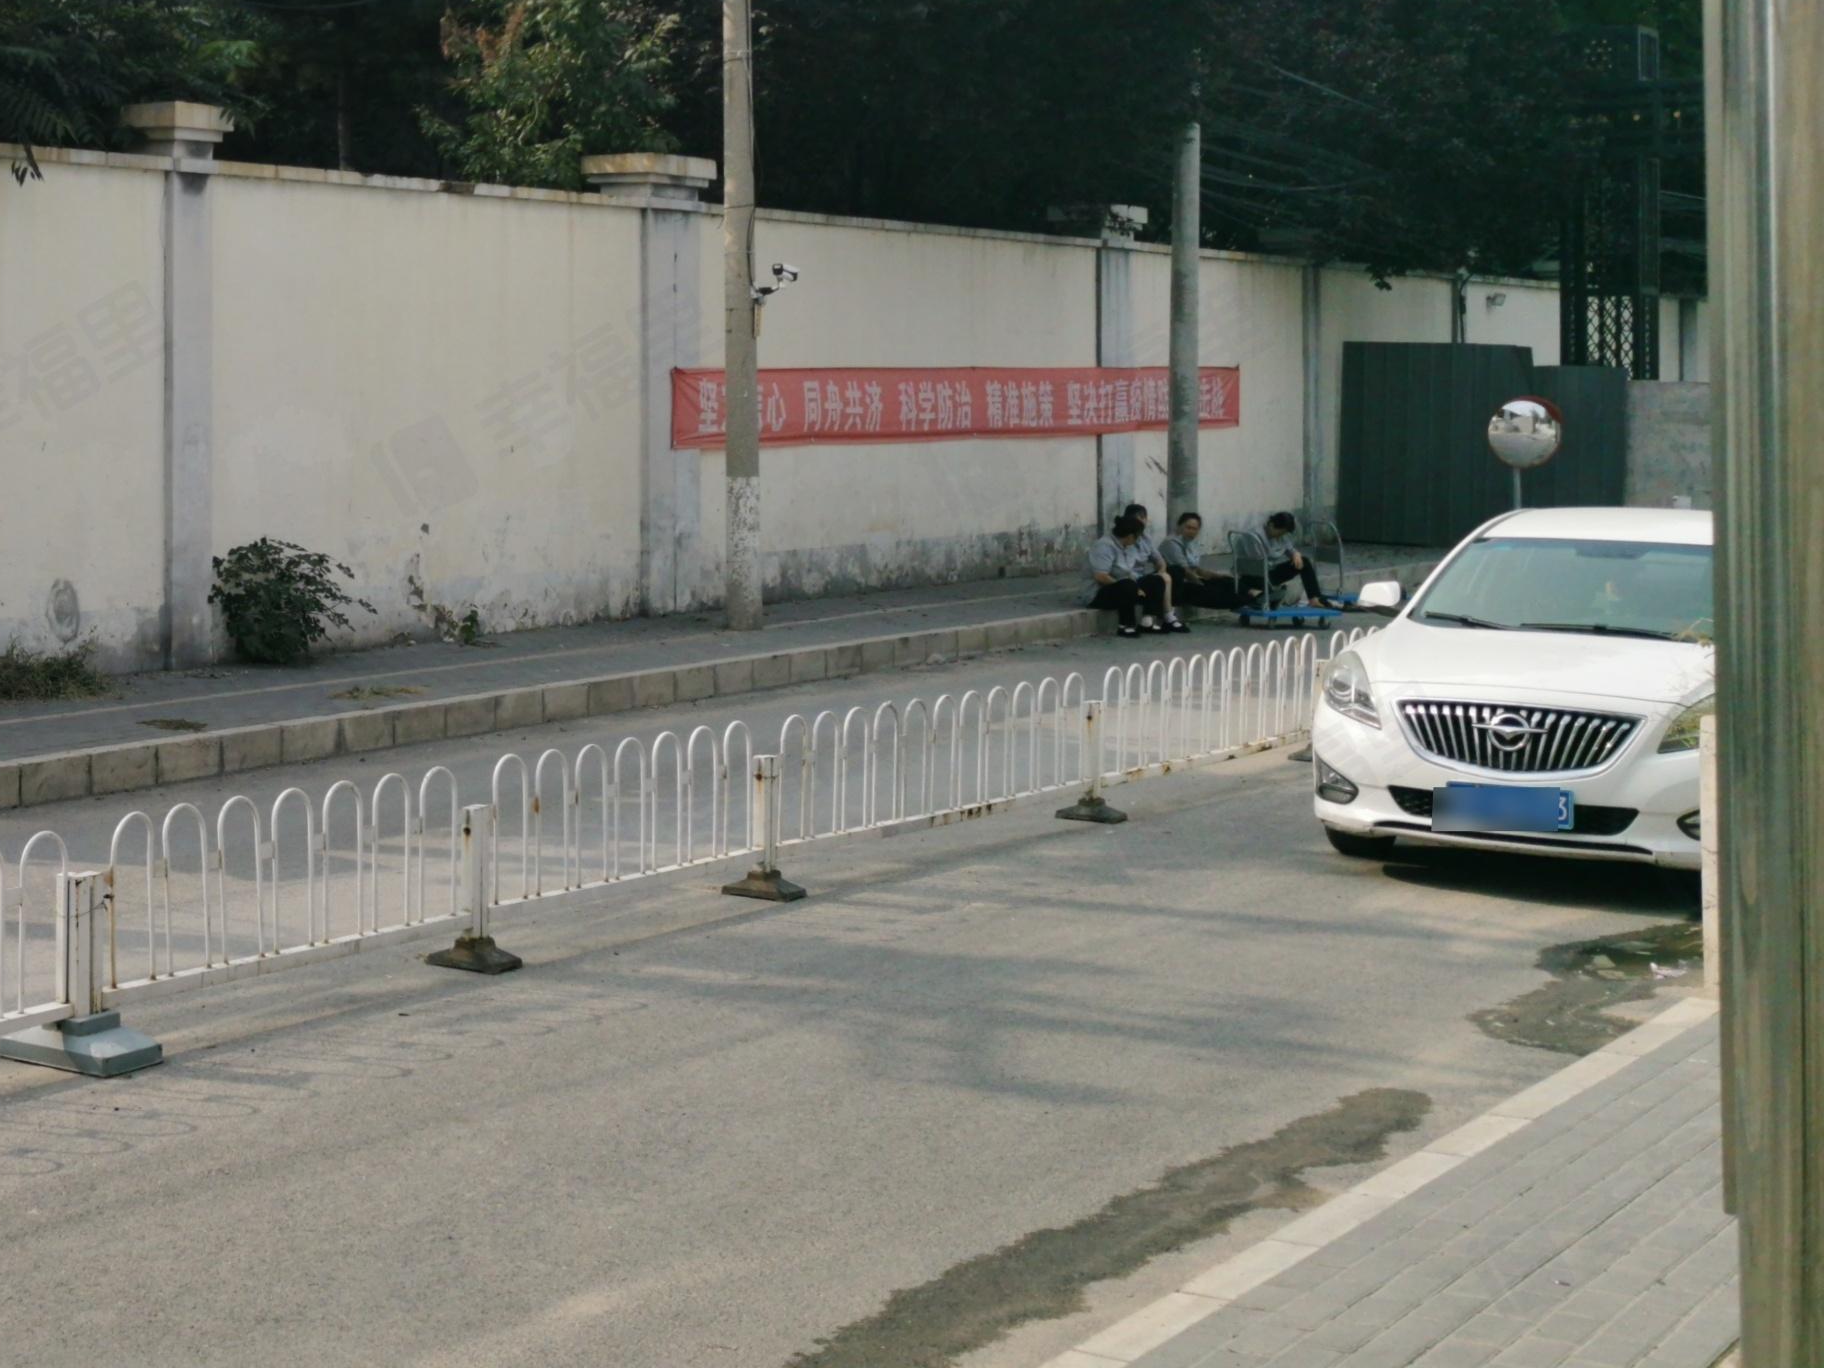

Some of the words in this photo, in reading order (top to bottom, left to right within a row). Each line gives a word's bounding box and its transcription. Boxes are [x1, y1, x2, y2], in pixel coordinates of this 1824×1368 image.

[698, 378, 786, 433] 坚心
[803, 378, 884, 433] 同舟共济
[897, 380, 972, 431] 科学防治
[984, 379, 1054, 429] 精准施策
